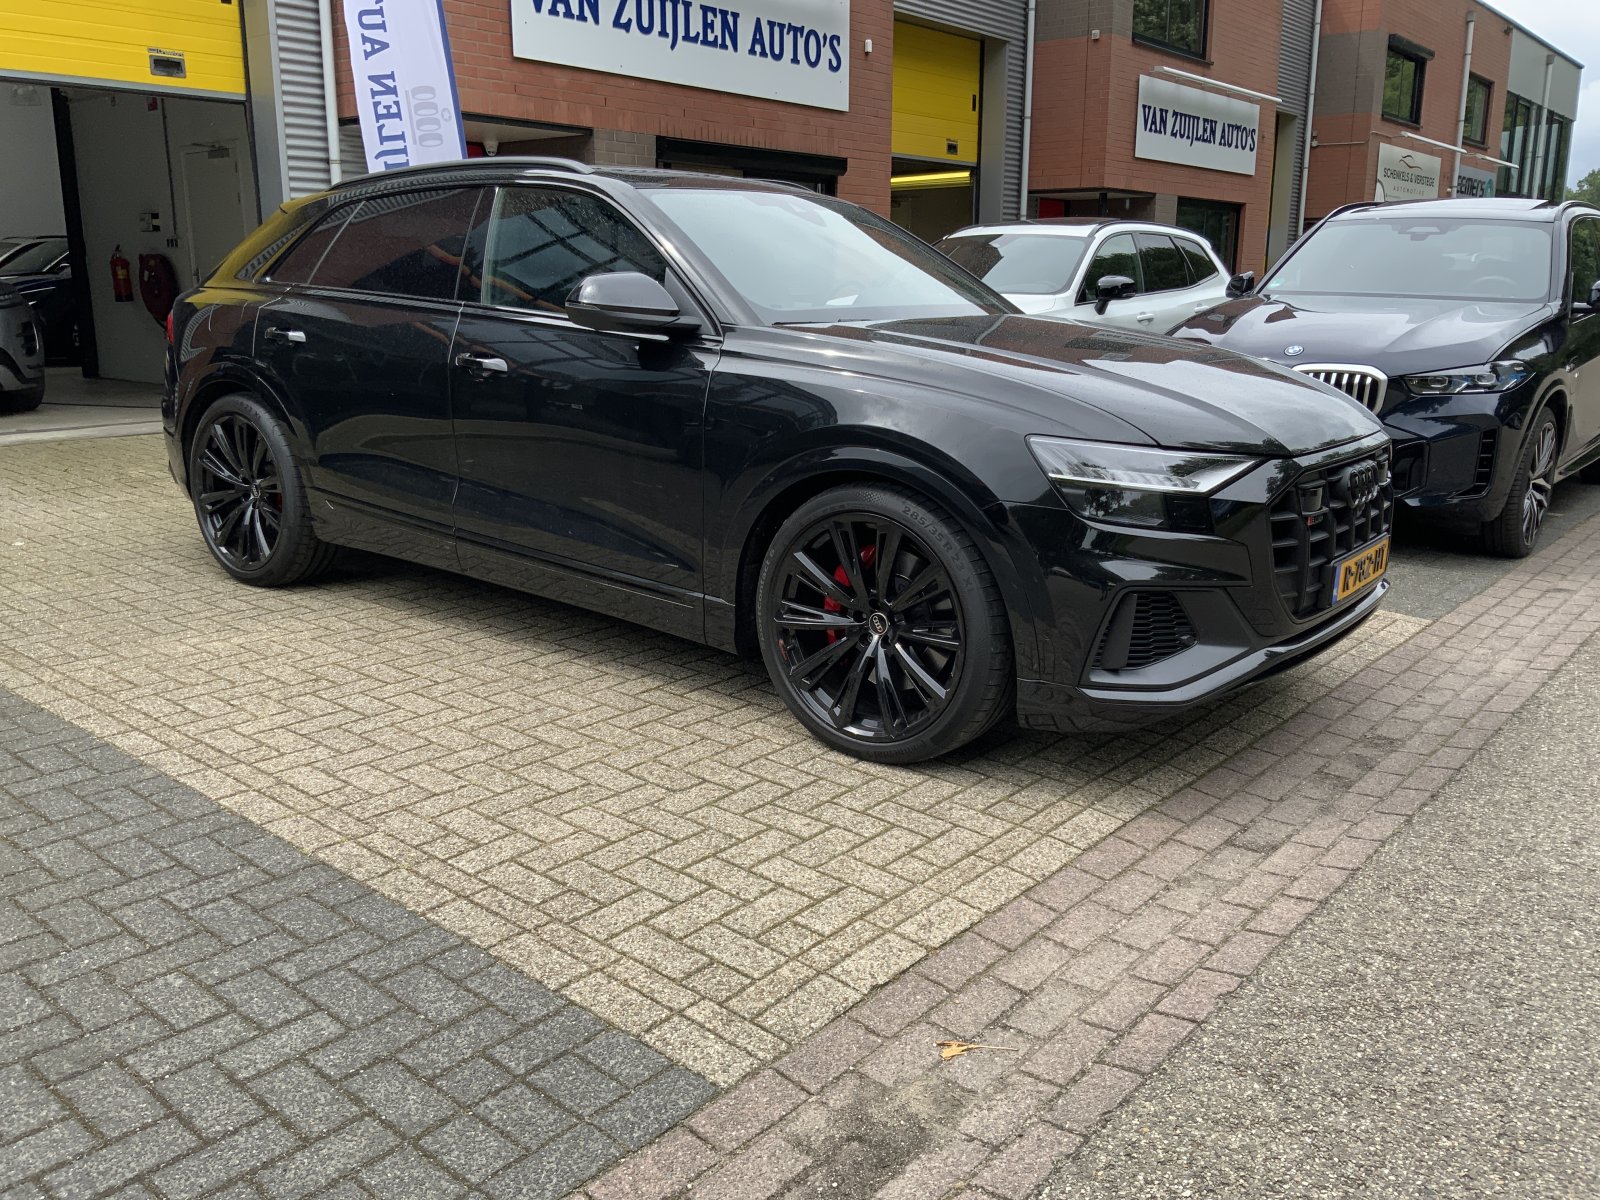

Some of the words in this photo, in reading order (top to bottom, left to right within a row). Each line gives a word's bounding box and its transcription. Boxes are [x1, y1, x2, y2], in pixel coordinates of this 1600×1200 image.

[612, 0, 740, 53] ZUIJLEN
[748, 17, 842, 73] AUTO'S
[1142, 104, 1169, 135] VAN
[1170, 109, 1218, 147] ZUIJLEN
[1219, 121, 1256, 152] AUTO'S
[902, 505, 945, 542] 285/35
